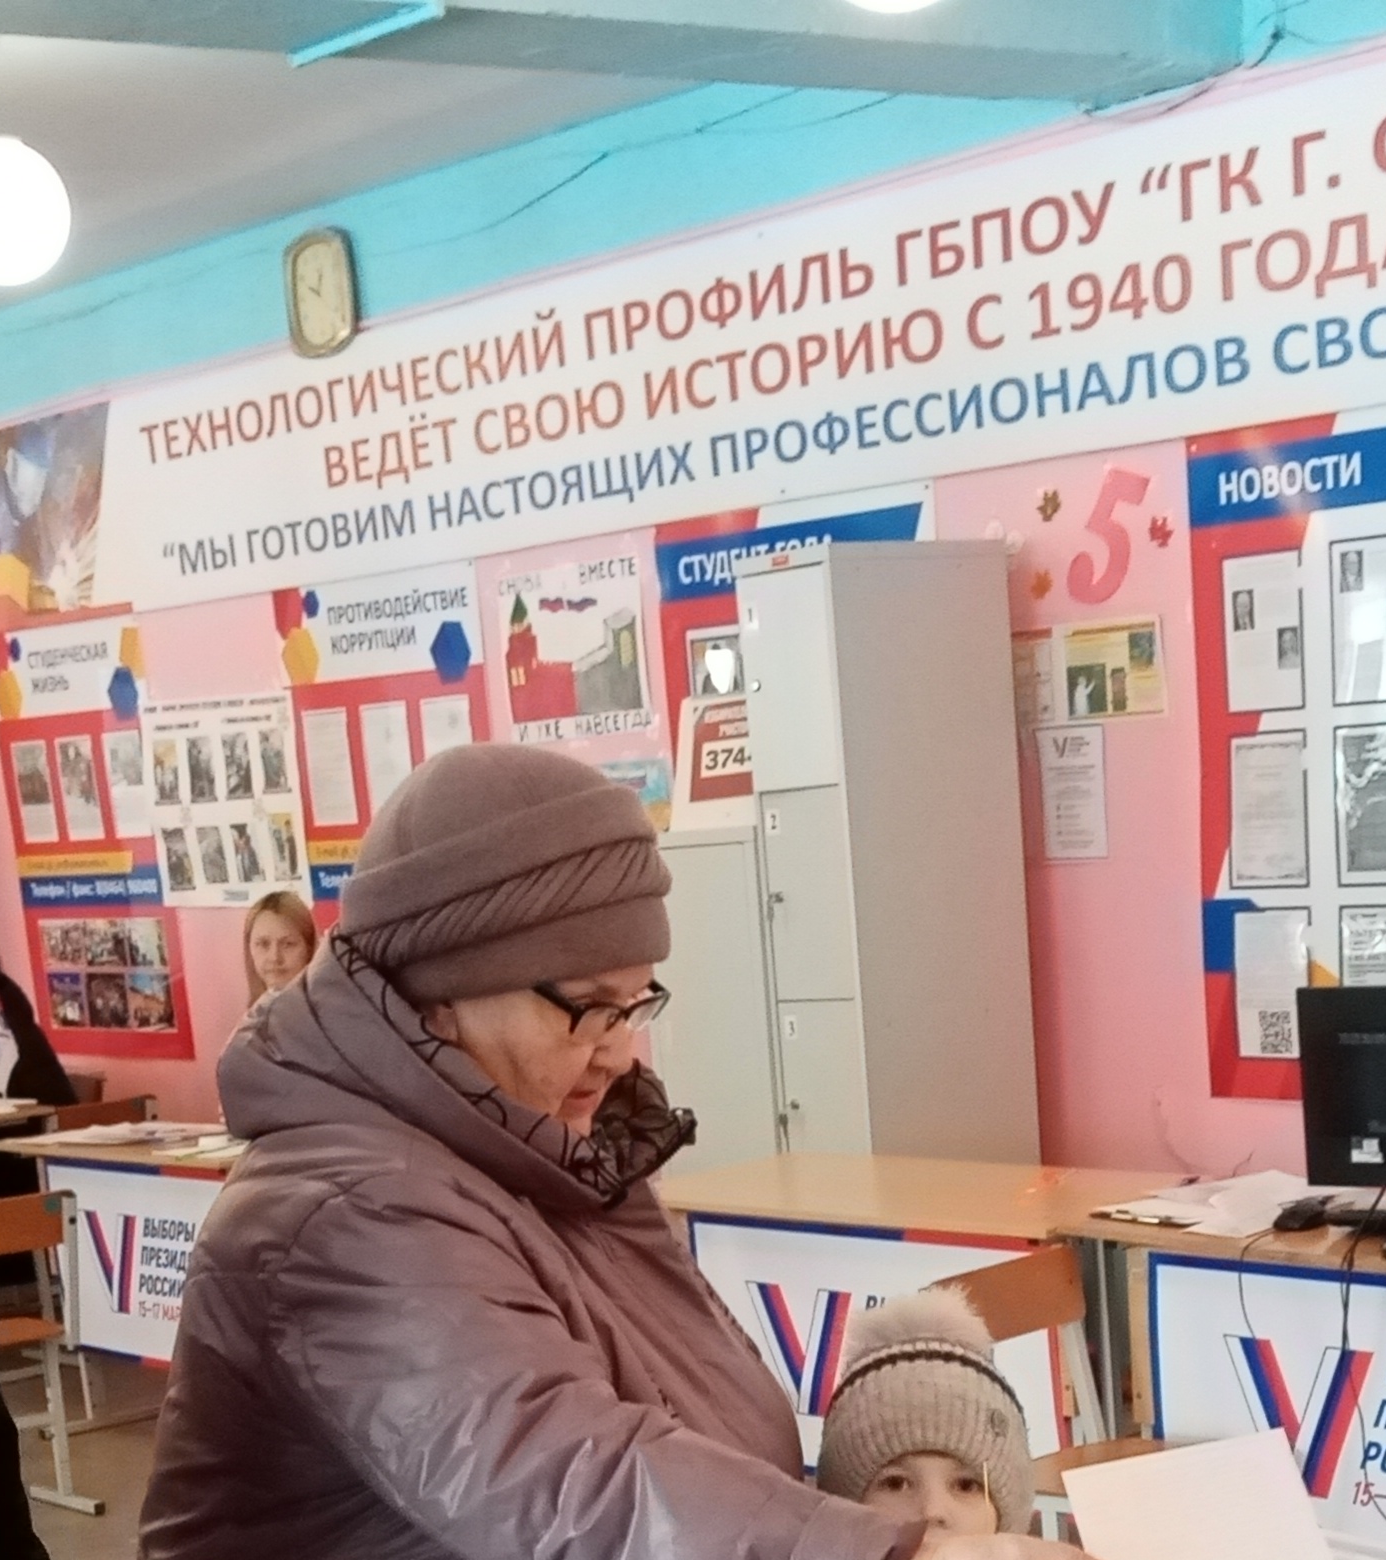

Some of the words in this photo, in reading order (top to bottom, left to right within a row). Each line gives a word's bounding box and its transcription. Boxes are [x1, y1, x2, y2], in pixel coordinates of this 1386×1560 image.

[139, 307, 566, 465] ТЕХНОЛОГИЧЕСКИЙ
[584, 247, 875, 360] ПРОФИЛЬ
[895, 181, 1115, 287] ГБПОУ
[1292, 130, 1342, 197] Г.
[323, 414, 457, 489] ВЕДЁТ
[474, 380, 625, 455] СВОЮ
[643, 307, 945, 420] ИСТОРИЮ
[967, 294, 1006, 351] С
[1028, 254, 1193, 341] 1940
[246, 500, 415, 565] ГОТОВИМ
[429, 441, 696, 532] НАСТОЯЩИХ
[711, 336, 1251, 478] ПРОФЕССИОНАЛОВ
[1218, 451, 1363, 506] НОВОСТИ
[579, 556, 637, 585] ВМЕСТЕ
[327, 586, 469, 625] ПРОТИВОДЕЙСТВИЕ
[330, 625, 417, 655] КОРРУПЦИИ
[28, 641, 108, 669] СТУДЕНЧЕСКАЯ
[31, 676, 69, 693] ЖИЗНЬ
[576, 711, 652, 735] НАВСЕГДА
[142, 1217, 196, 1242] ВЫБОРЫ
[140, 1245, 192, 1273] ПРЕЗИД
